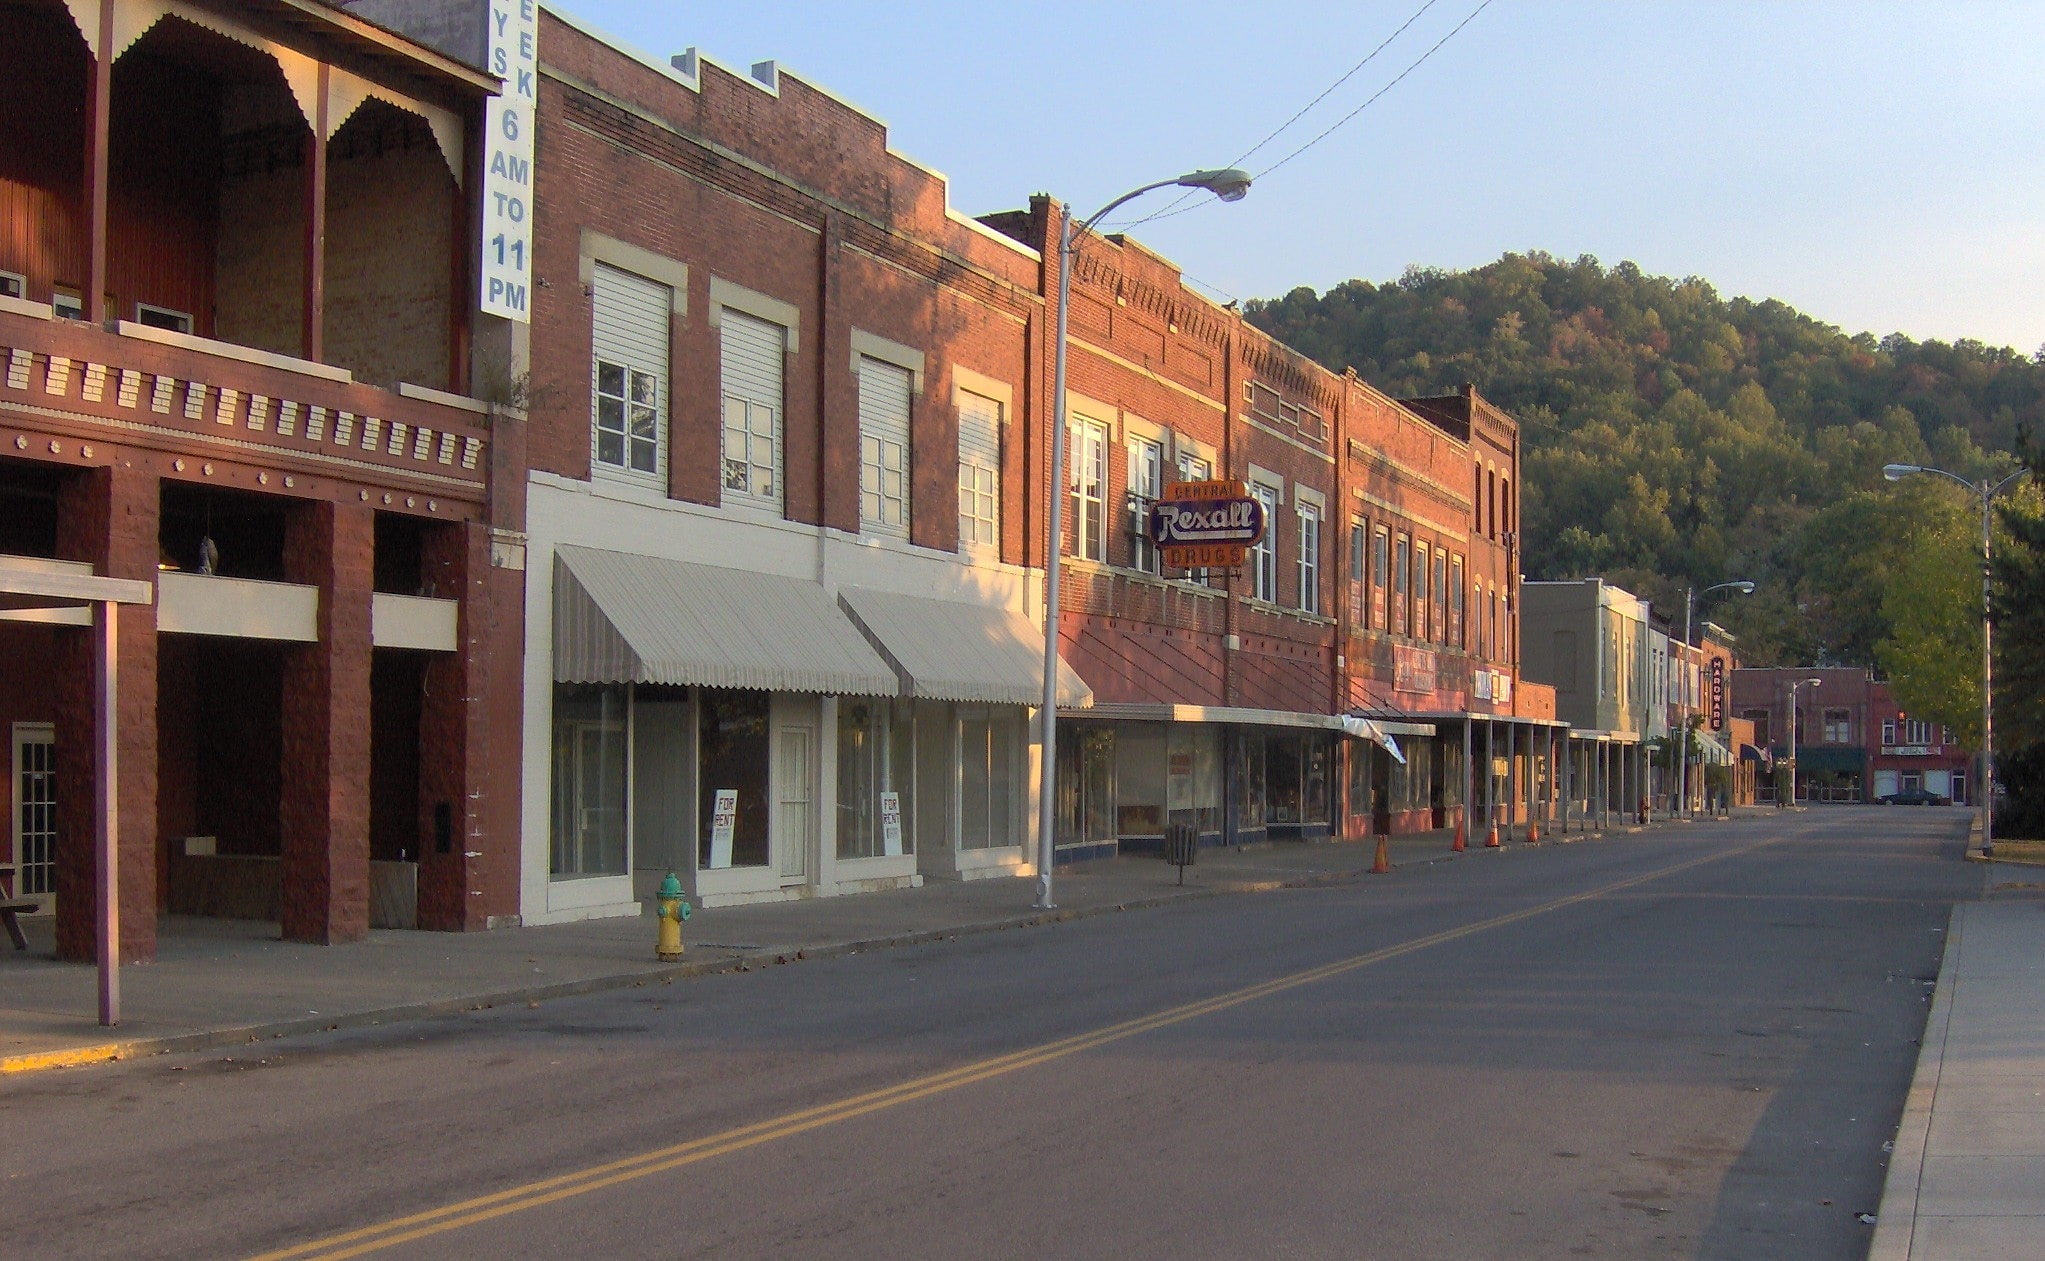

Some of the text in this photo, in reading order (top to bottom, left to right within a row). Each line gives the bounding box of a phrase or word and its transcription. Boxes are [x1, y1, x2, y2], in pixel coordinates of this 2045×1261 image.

[494, 0, 508, 75] YS
[501, 108, 518, 141] 6
[490, 150, 529, 186] AM
[493, 191, 524, 223] TO
[492, 233, 524, 271] 11
[489, 277, 526, 312] PM
[1157, 501, 1255, 542] Rexall
[1171, 547, 1242, 565] DRUGS
[1713, 660, 1721, 728] HARDWARE
[715, 813, 736, 827] RENT
[718, 797, 735, 811] FOR
[883, 812, 900, 825] RENT
[884, 798, 898, 811] FOR
